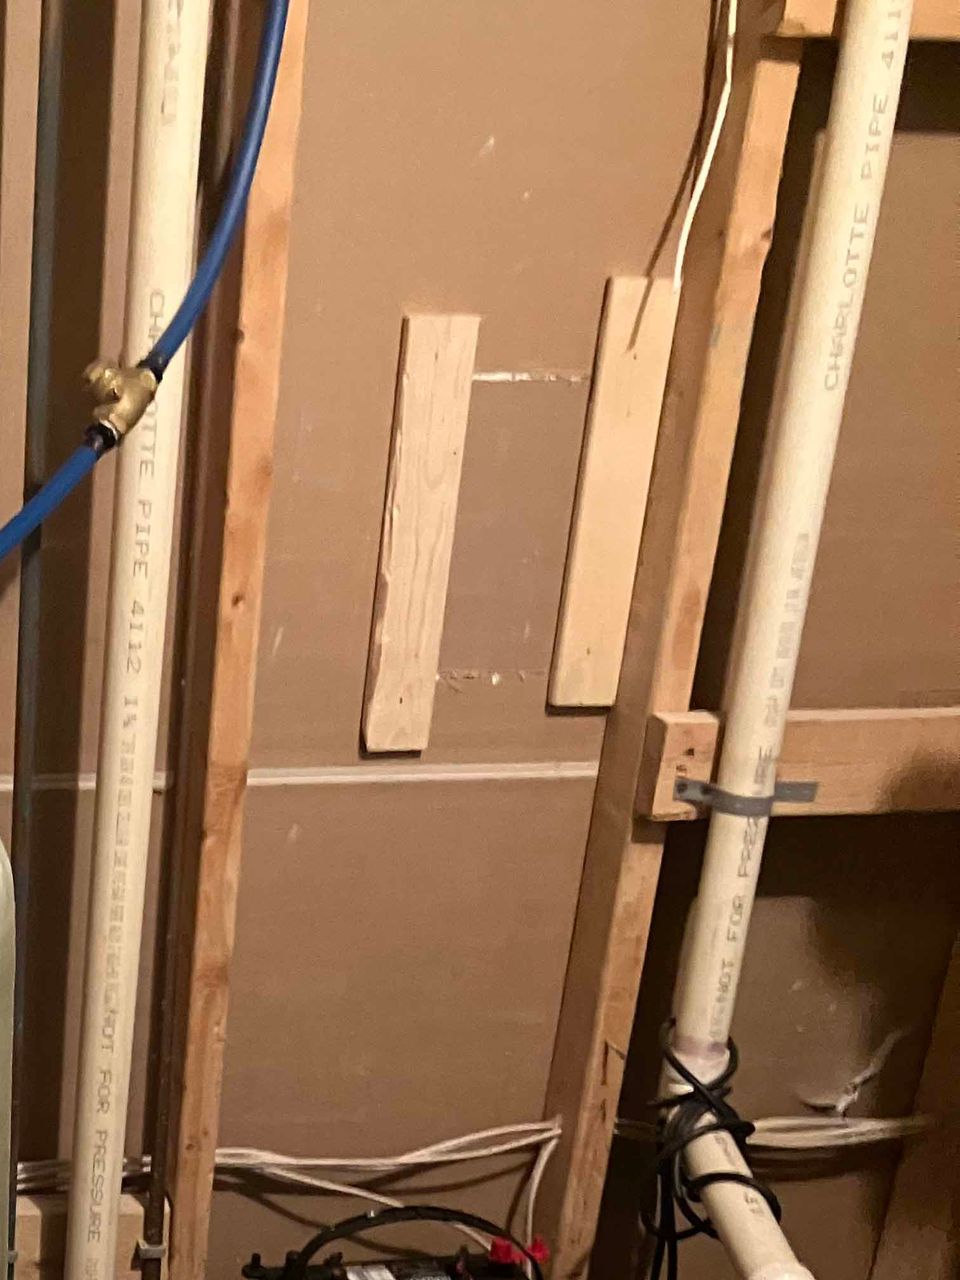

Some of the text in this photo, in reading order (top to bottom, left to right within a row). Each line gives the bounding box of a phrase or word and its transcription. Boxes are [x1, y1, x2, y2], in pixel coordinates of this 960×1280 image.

[860, 94, 888, 180] PIPE
[133, 498, 152, 579] PIPE
[126, 600, 145, 674] 4112
[726, 894, 745, 943] FOR
[96, 1069, 113, 1114] FOR
[87, 1129, 108, 1243] PRESSURE
